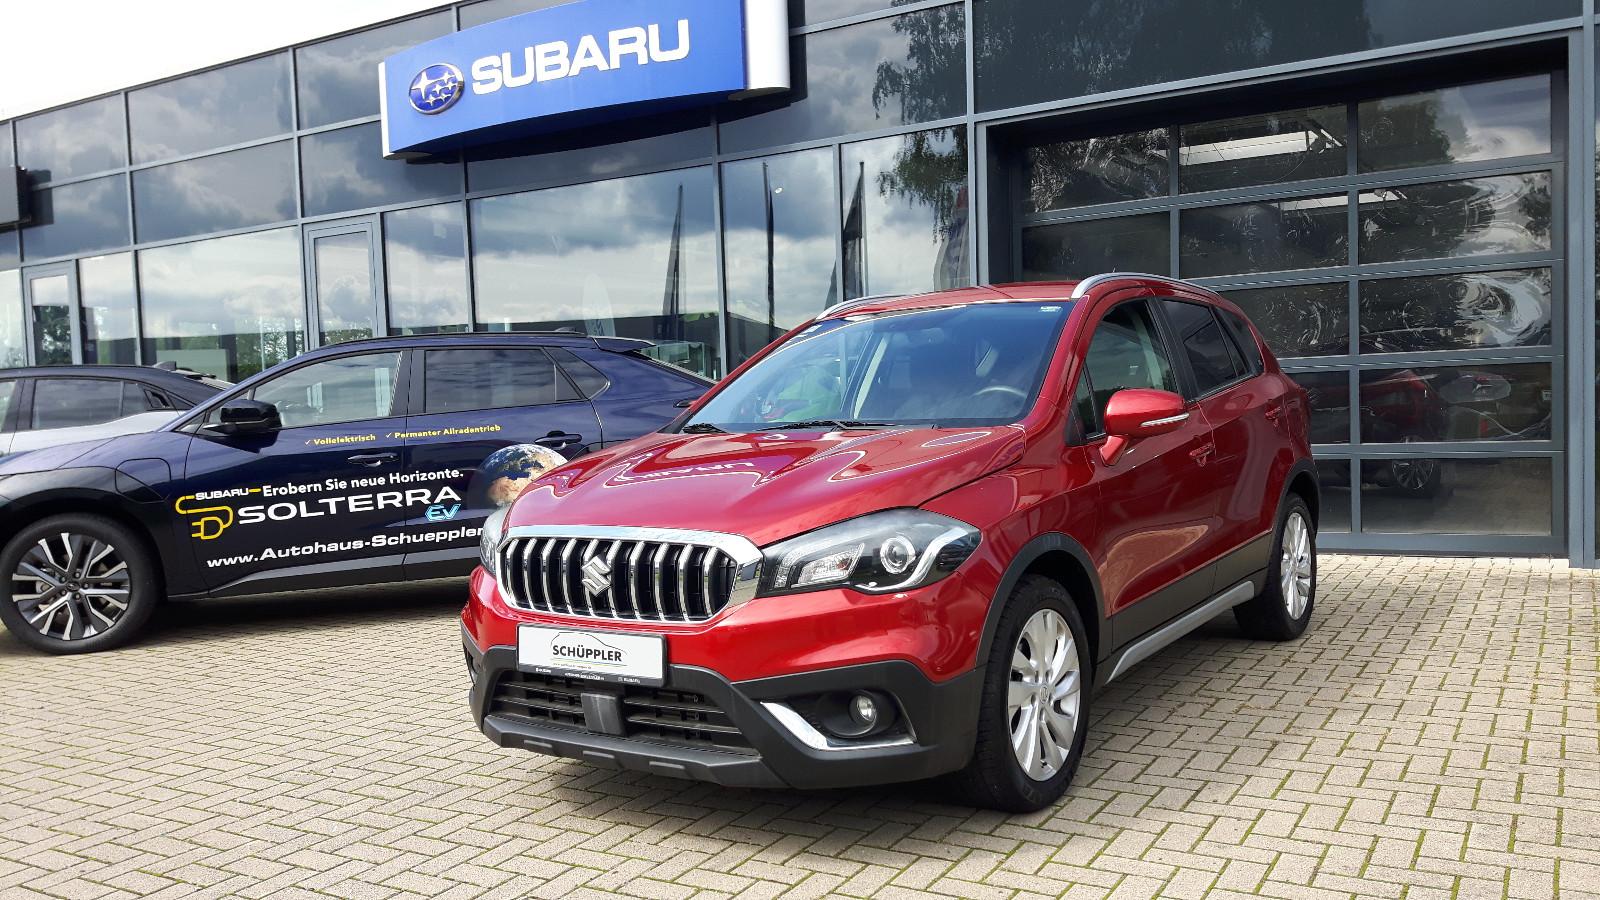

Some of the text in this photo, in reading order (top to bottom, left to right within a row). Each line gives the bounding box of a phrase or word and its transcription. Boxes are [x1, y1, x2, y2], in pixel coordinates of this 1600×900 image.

[471, 19, 690, 95] SUBARU
[313, 434, 376, 446] Vollelektrisch
[262, 468, 464, 497] Erobern Sie neue Horizonte.
[195, 487, 250, 501] SUBARU
[237, 485, 462, 525] SOLTERRA
[424, 503, 461, 524] EV
[552, 644, 622, 662] SCHÜPPLER
